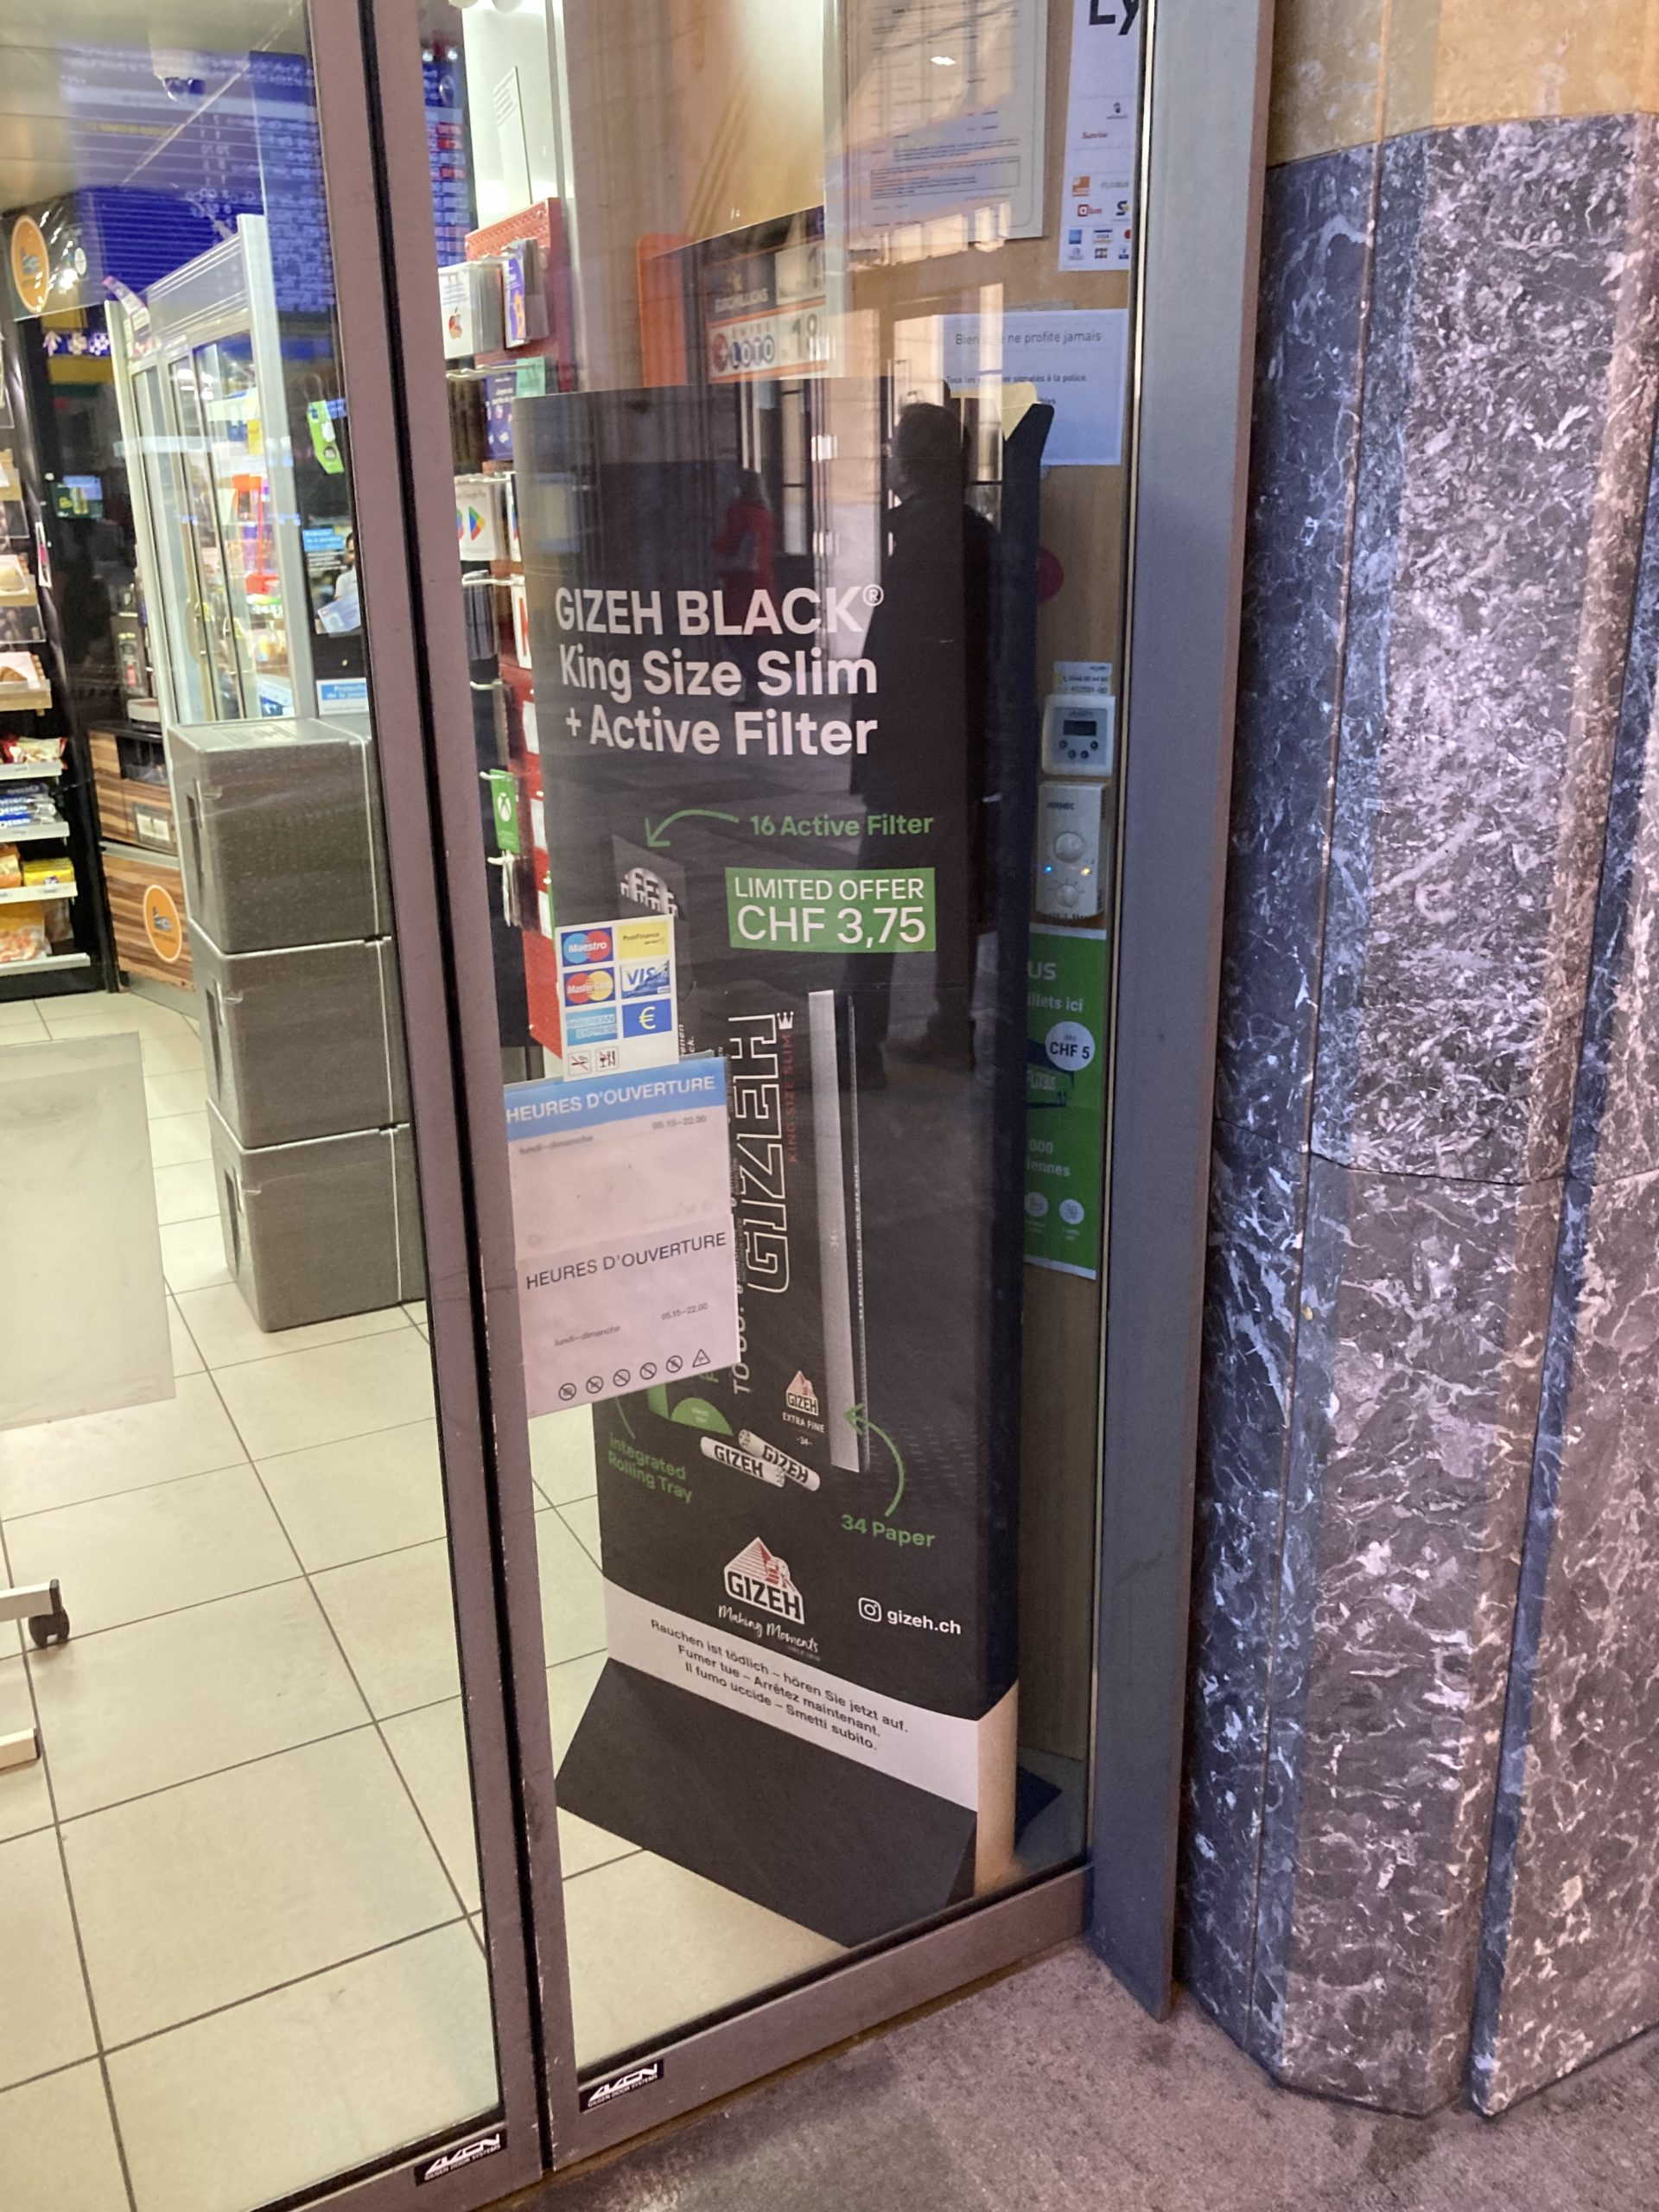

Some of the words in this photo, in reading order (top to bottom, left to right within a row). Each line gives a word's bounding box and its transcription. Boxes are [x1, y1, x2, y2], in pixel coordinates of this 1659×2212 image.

[1007, 334, 1022, 344] ne
[1024, 331, 1060, 346] profite
[1063, 331, 1102, 346] jamais
[555, 588, 663, 635] GIZEH
[560, 644, 632, 703] King
[643, 648, 742, 696] Size
[758, 646, 877, 696] Slim
[734, 709, 878, 756] Filter
[750, 816, 776, 836] 16
[781, 815, 861, 837] Active
[867, 815, 934, 836] Filter
[734, 877, 833, 900] LIMITED
[839, 879, 925, 900] OFFER
[569, 941, 607, 954] Maestro
[737, 906, 826, 944] CHF
[836, 906, 926, 950] 3,75
[1066, 996, 1084, 1013] ici
[1049, 1041, 1078, 1058] CHF
[1082, 1046, 1091, 1060] 5
[505, 1096, 583, 1126] HEURES
[587, 1076, 716, 1109] D'OUVERTURE
[728, 1013, 790, 1294] GIZEH
[526, 1260, 598, 1290] HEURES
[603, 1231, 728, 1271] D'OUVERTURE
[782, 1412, 806, 1427] EXTRA
[807, 1421, 825, 1433] FINE
[788, 1394, 817, 1414] GIZEH
[608, 1450, 656, 1490] Rolling
[657, 1475, 692, 1504] Tray
[715, 1445, 764, 1478] GIZEH
[762, 1445, 809, 1484] GIZEH
[841, 1514, 868, 1535] 34
[872, 1521, 936, 1547] Paper
[728, 1571, 802, 1621] GIZEH
[718, 1605, 763, 1638] Making
[766, 1623, 819, 1653] Moments
[887, 1610, 962, 1635] gizeh.ch
[651, 1618, 704, 1649] Rauchen
[707, 1640, 722, 1656] ist
[726, 1649, 769, 1675] tödlich
[784, 1672, 822, 1697] hören
[825, 1688, 846, 1707] Sie
[849, 1699, 878, 1721] jetzt
[882, 1713, 908, 1733] auf.
[677, 1643, 716, 1669] Fumer
[721, 1661, 740, 1678] tue
[754, 1675, 800, 1704] Arrêtez
[803, 1695, 881, 1737] maintenant.
[696, 1665, 727, 1688] fumo
[730, 1681, 772, 1707] uccide
[785, 1703, 827, 1730] Smetti
[831, 1723, 878, 1751] subito.
